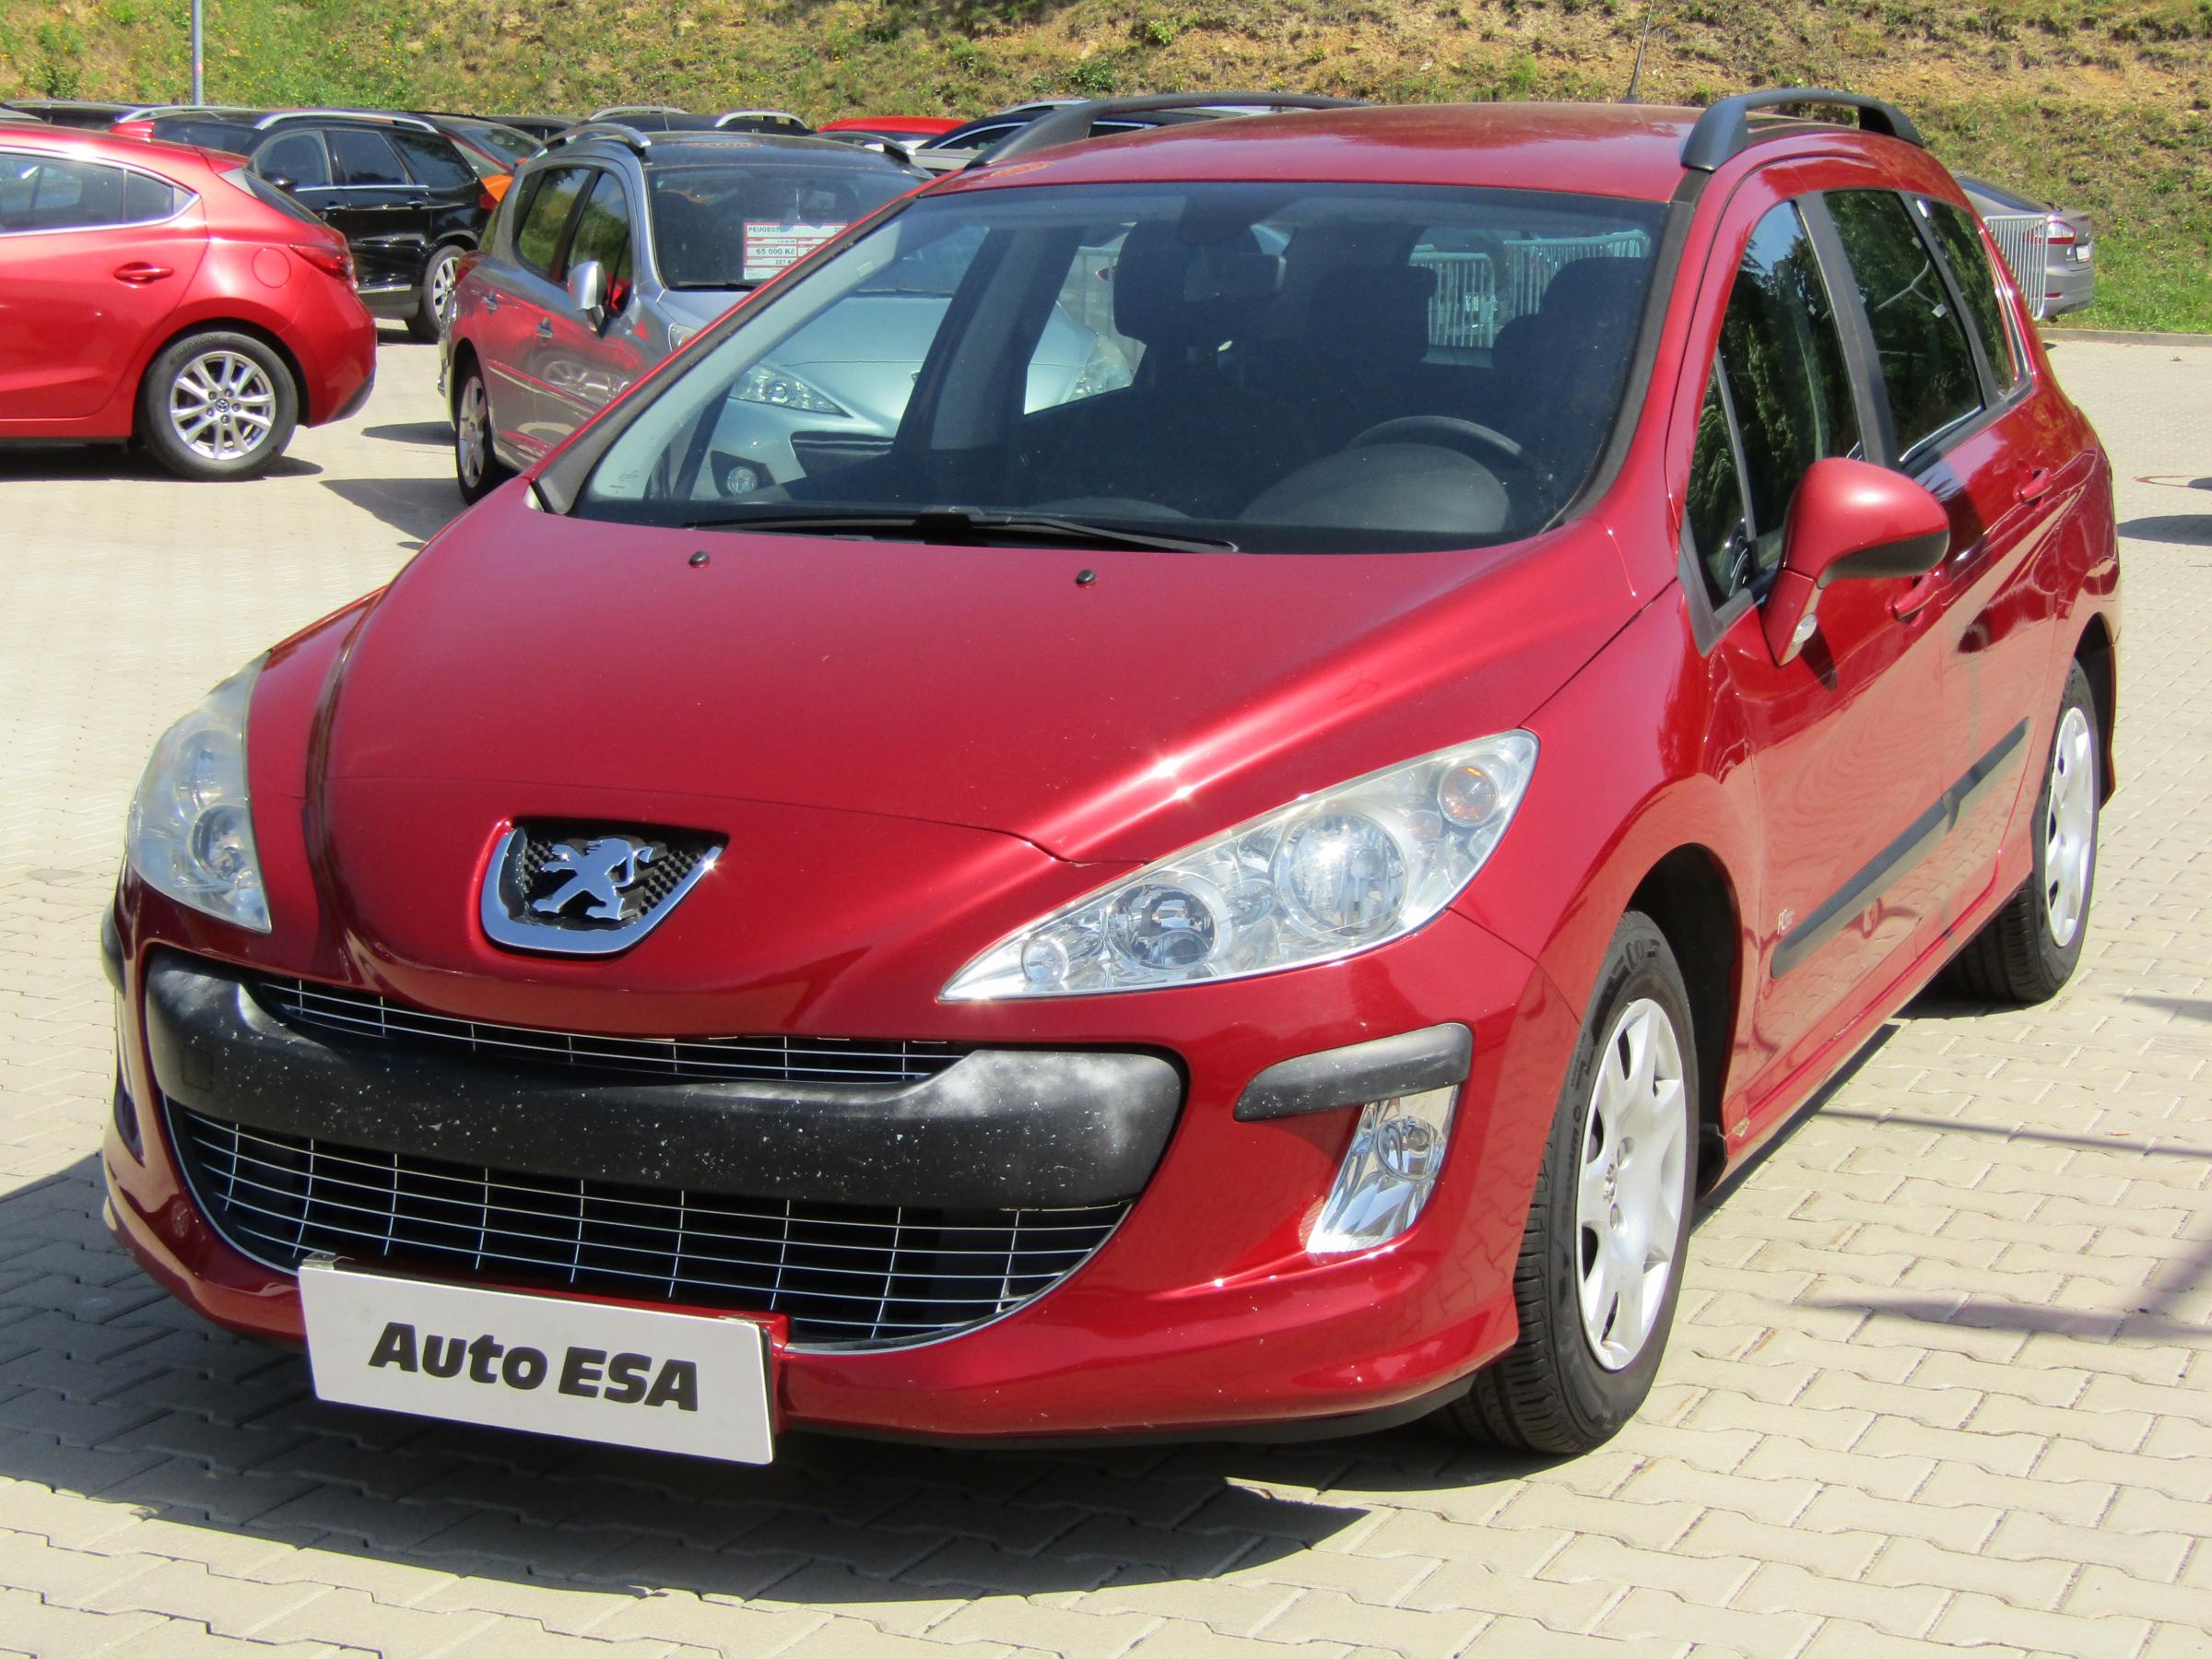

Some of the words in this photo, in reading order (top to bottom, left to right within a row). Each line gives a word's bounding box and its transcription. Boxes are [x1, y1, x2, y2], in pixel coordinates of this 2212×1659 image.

[784, 247, 795, 255] Kč
[368, 1321, 547, 1390] Auto
[558, 1346, 698, 1412] ESA
